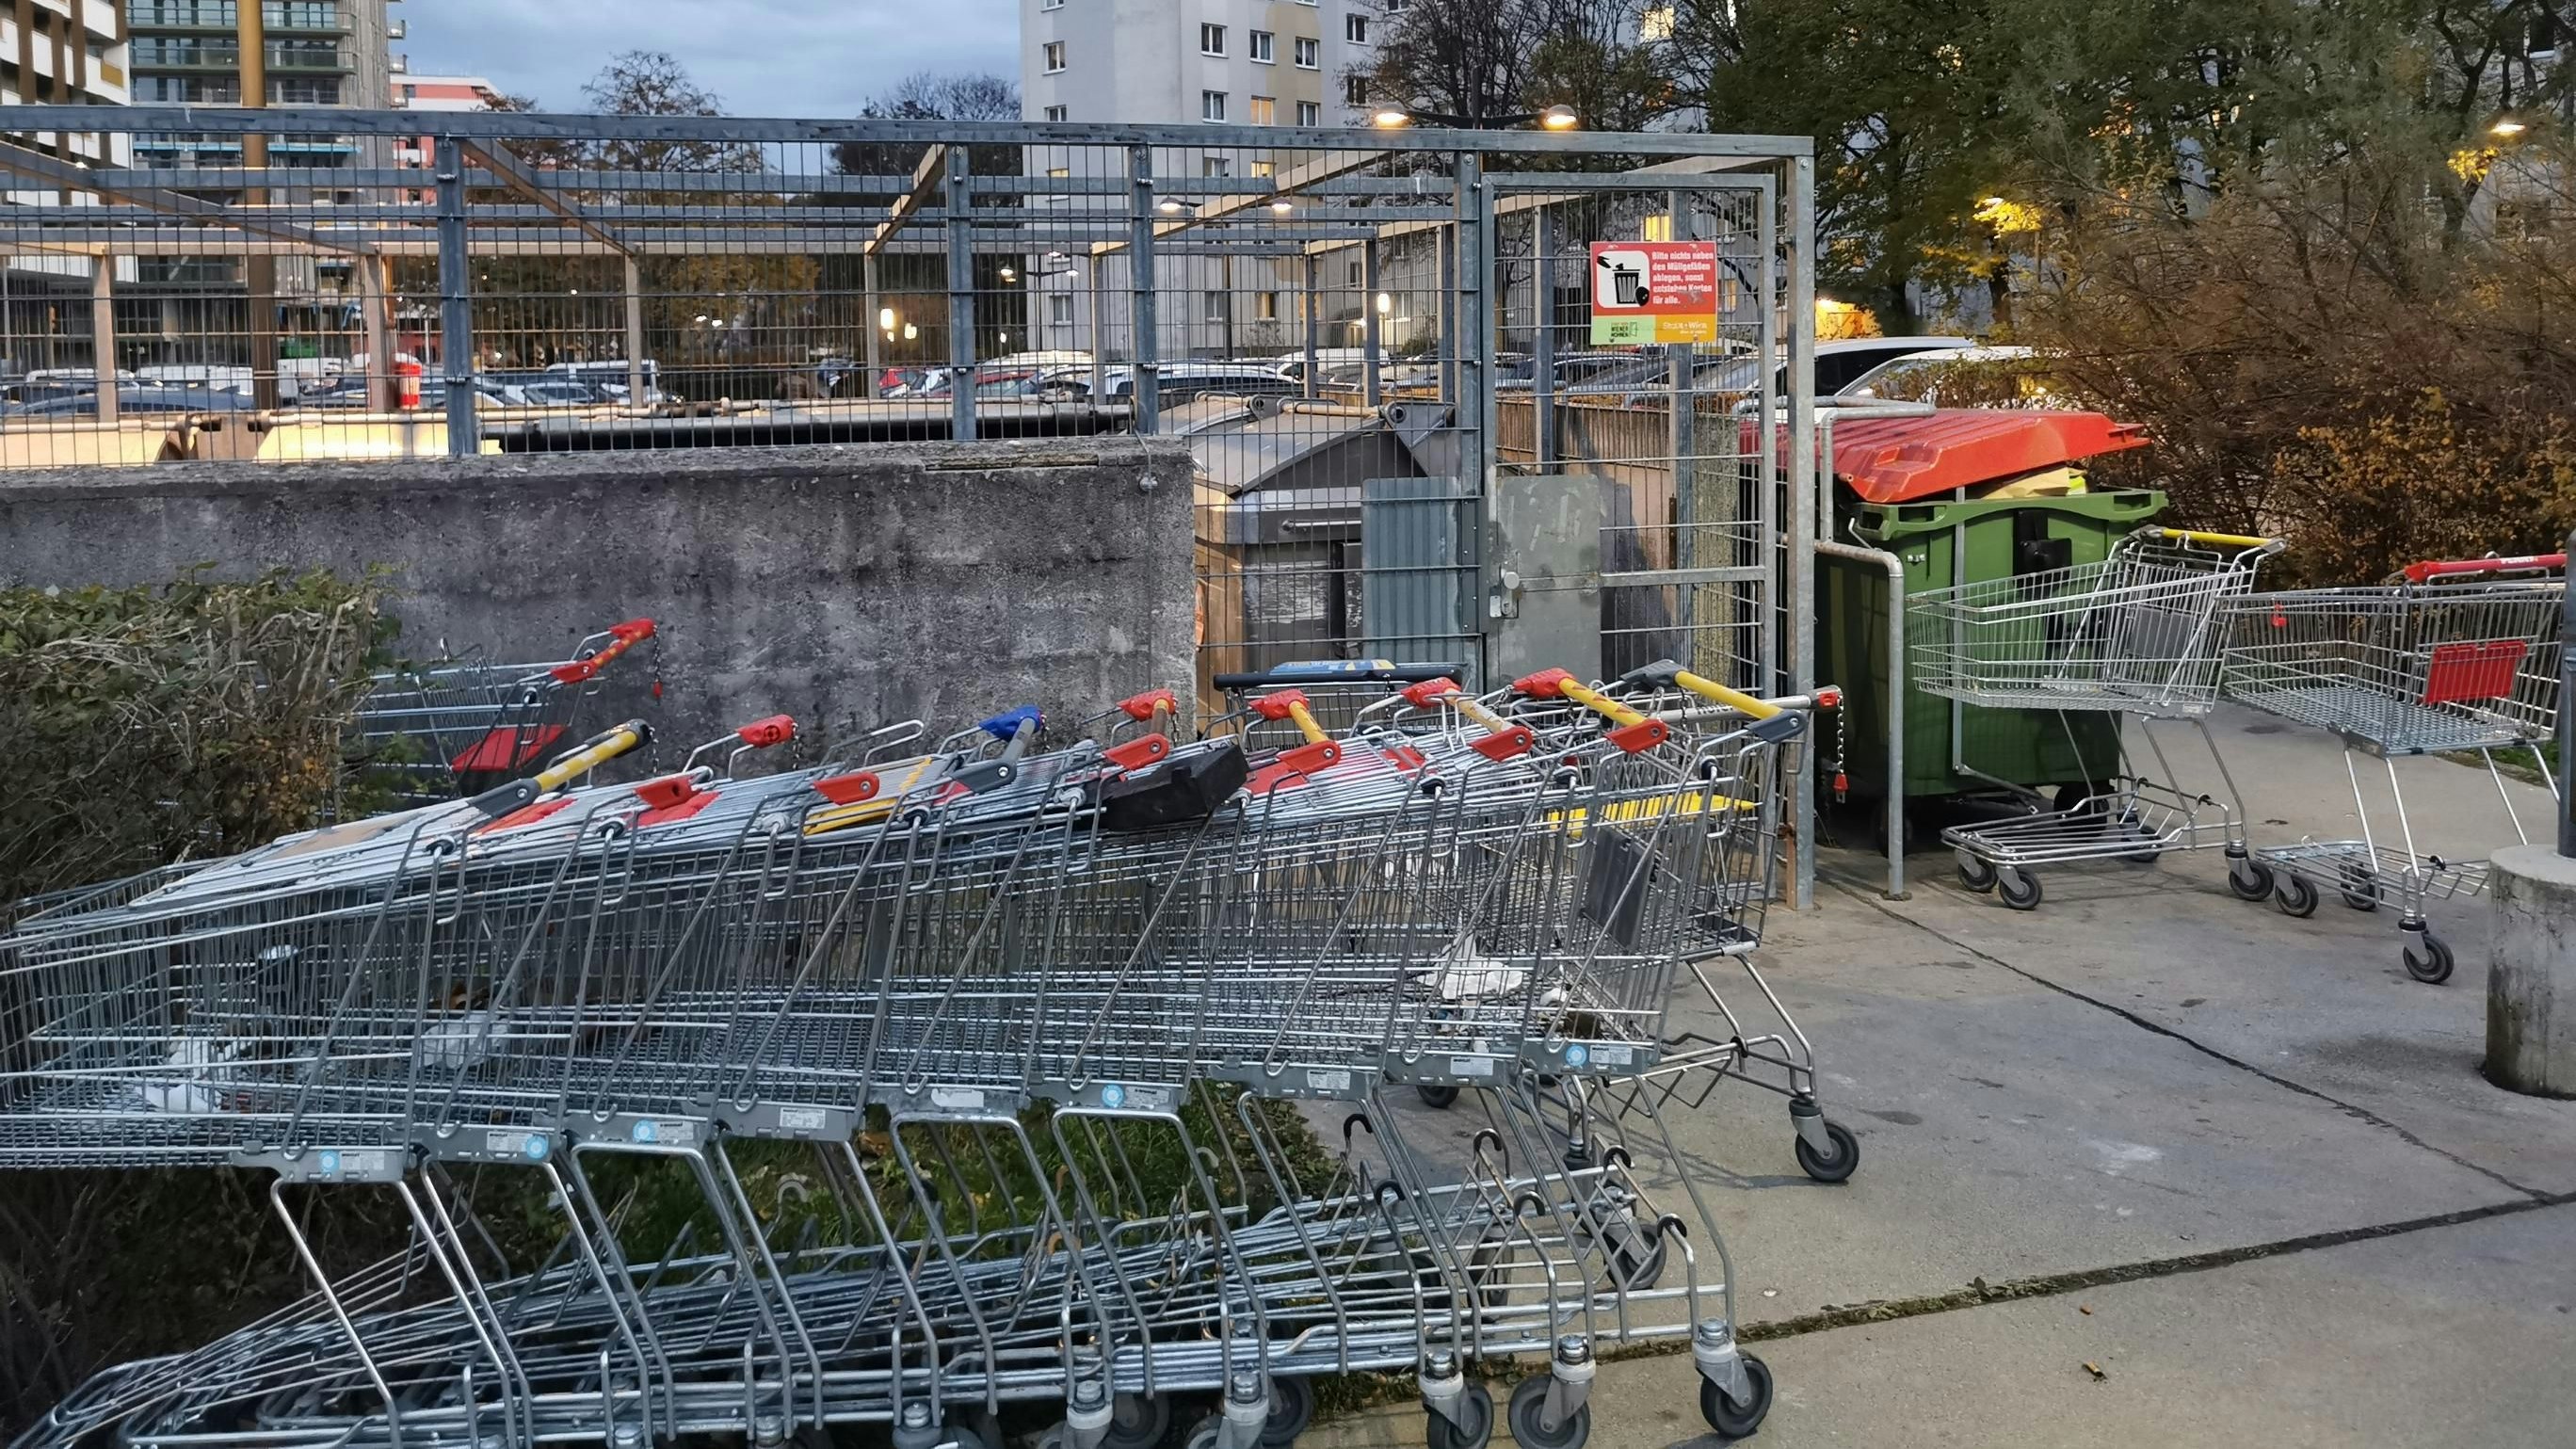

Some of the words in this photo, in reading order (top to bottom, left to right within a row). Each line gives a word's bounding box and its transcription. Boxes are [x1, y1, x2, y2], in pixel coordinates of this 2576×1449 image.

[1652, 251, 1668, 260] Bitte
[1670, 251, 1691, 260] nichts
[1692, 251, 1714, 260] neben
[1653, 273, 1683, 283] ablegen,
[1652, 296, 1664, 304] für
